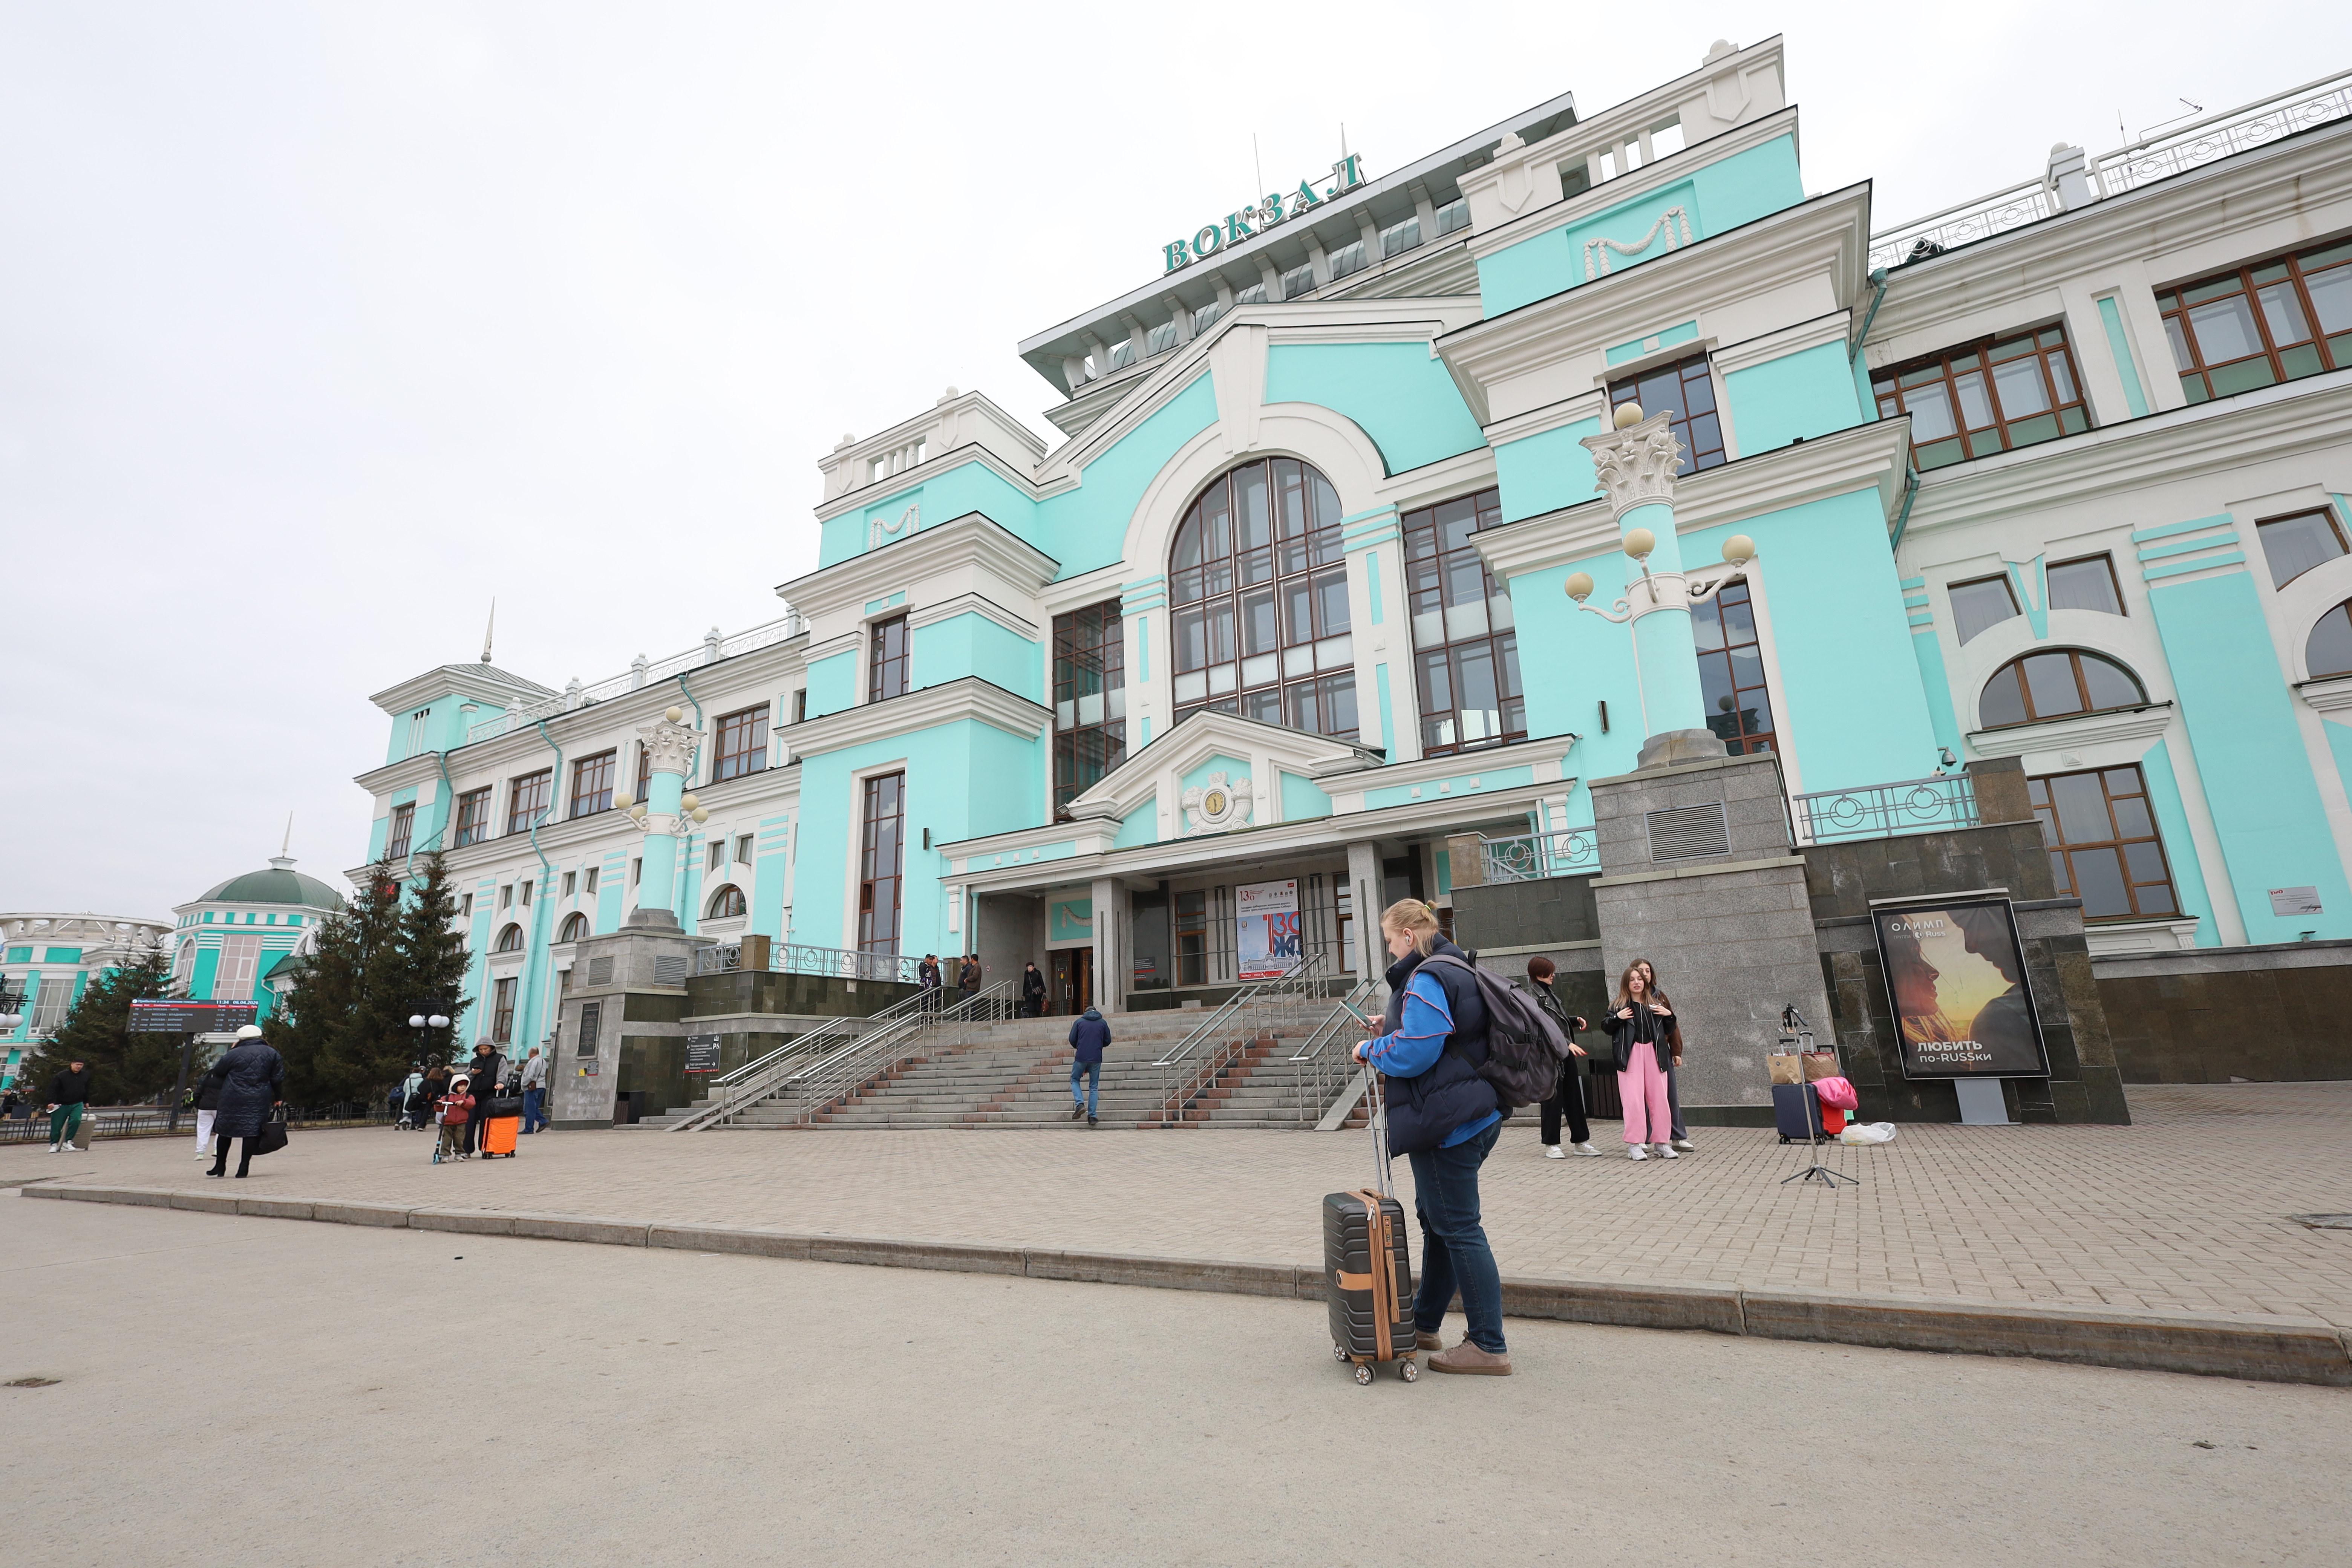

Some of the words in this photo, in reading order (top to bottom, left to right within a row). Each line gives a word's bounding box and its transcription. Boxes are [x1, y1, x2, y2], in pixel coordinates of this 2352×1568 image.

[1162, 152, 1362, 277] ВОКЗАЛ
[1240, 891, 1255, 902] 130
[1891, 919, 1944, 931] ОЛИМП
[1917, 1041, 1983, 1052] ЛЮБИТЬ
